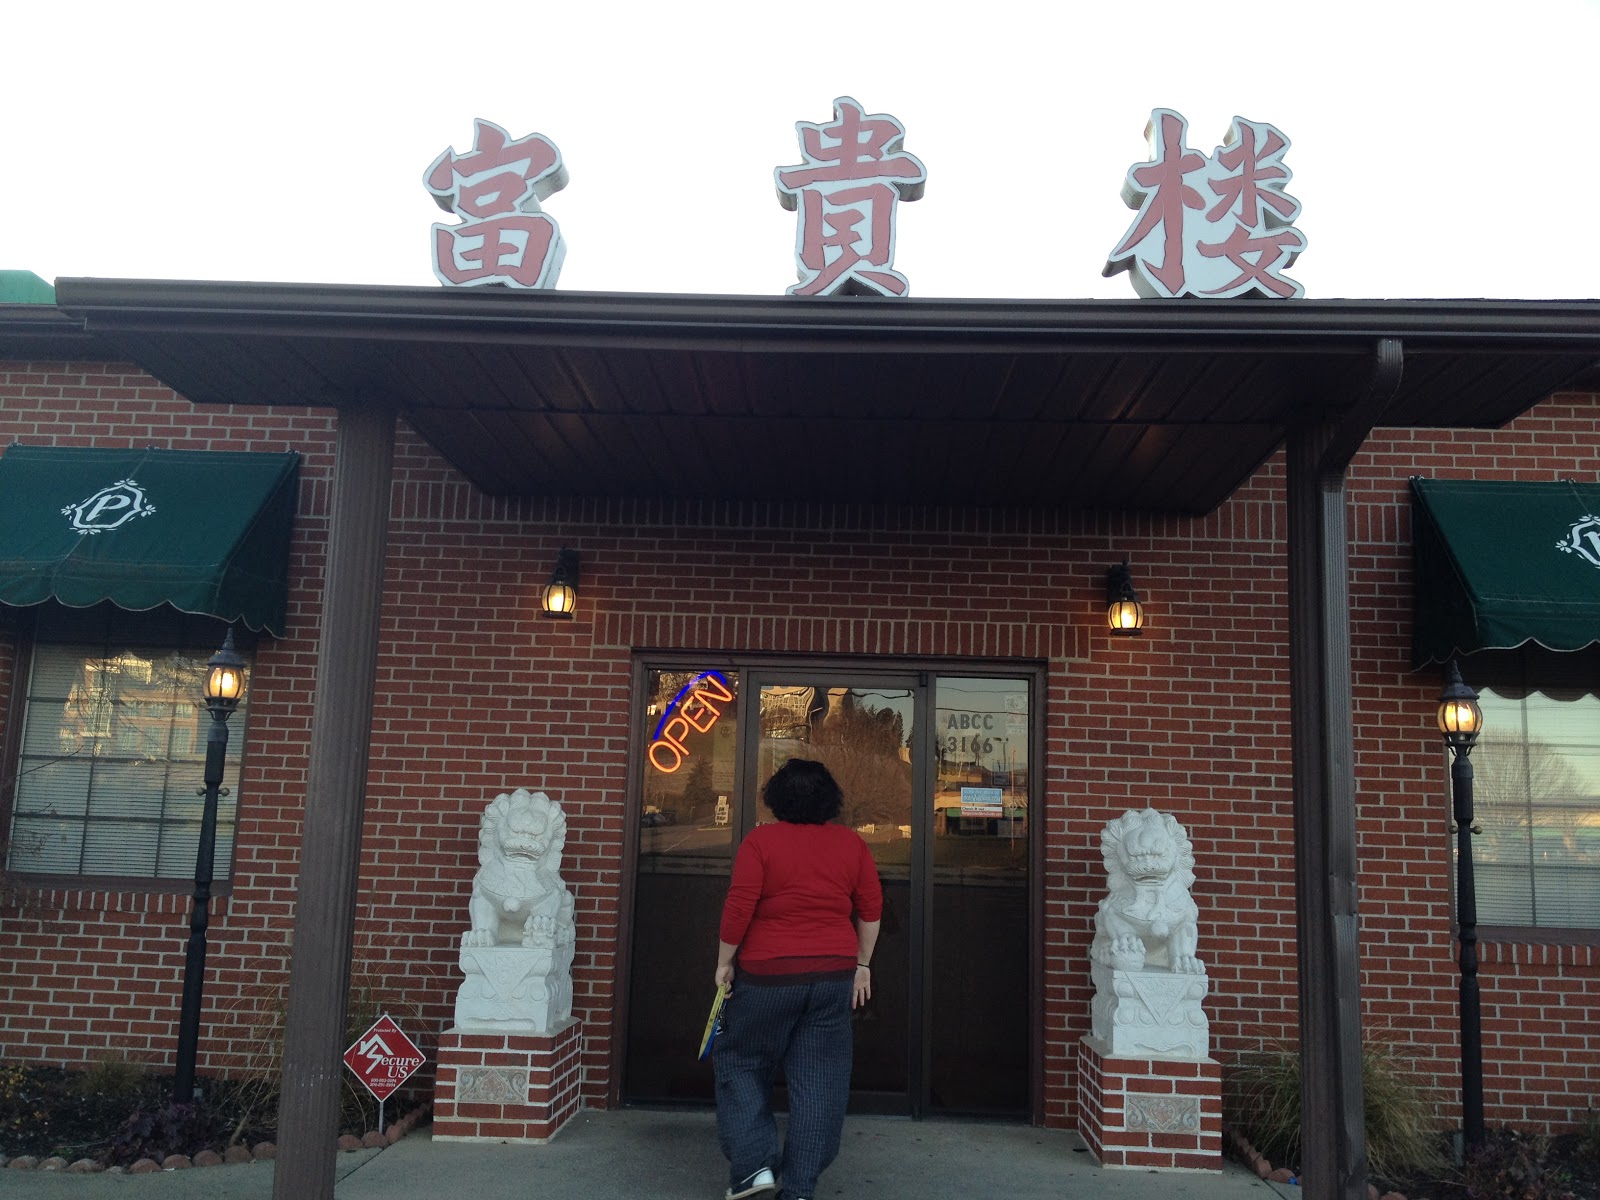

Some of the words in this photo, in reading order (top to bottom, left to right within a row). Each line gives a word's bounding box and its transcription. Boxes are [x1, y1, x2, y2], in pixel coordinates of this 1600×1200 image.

[86, 495, 131, 521] P
[649, 675, 733, 773] OPEN
[947, 714, 993, 730] ABCC
[947, 734, 993, 753] 3166
[387, 1066, 408, 1078] US
